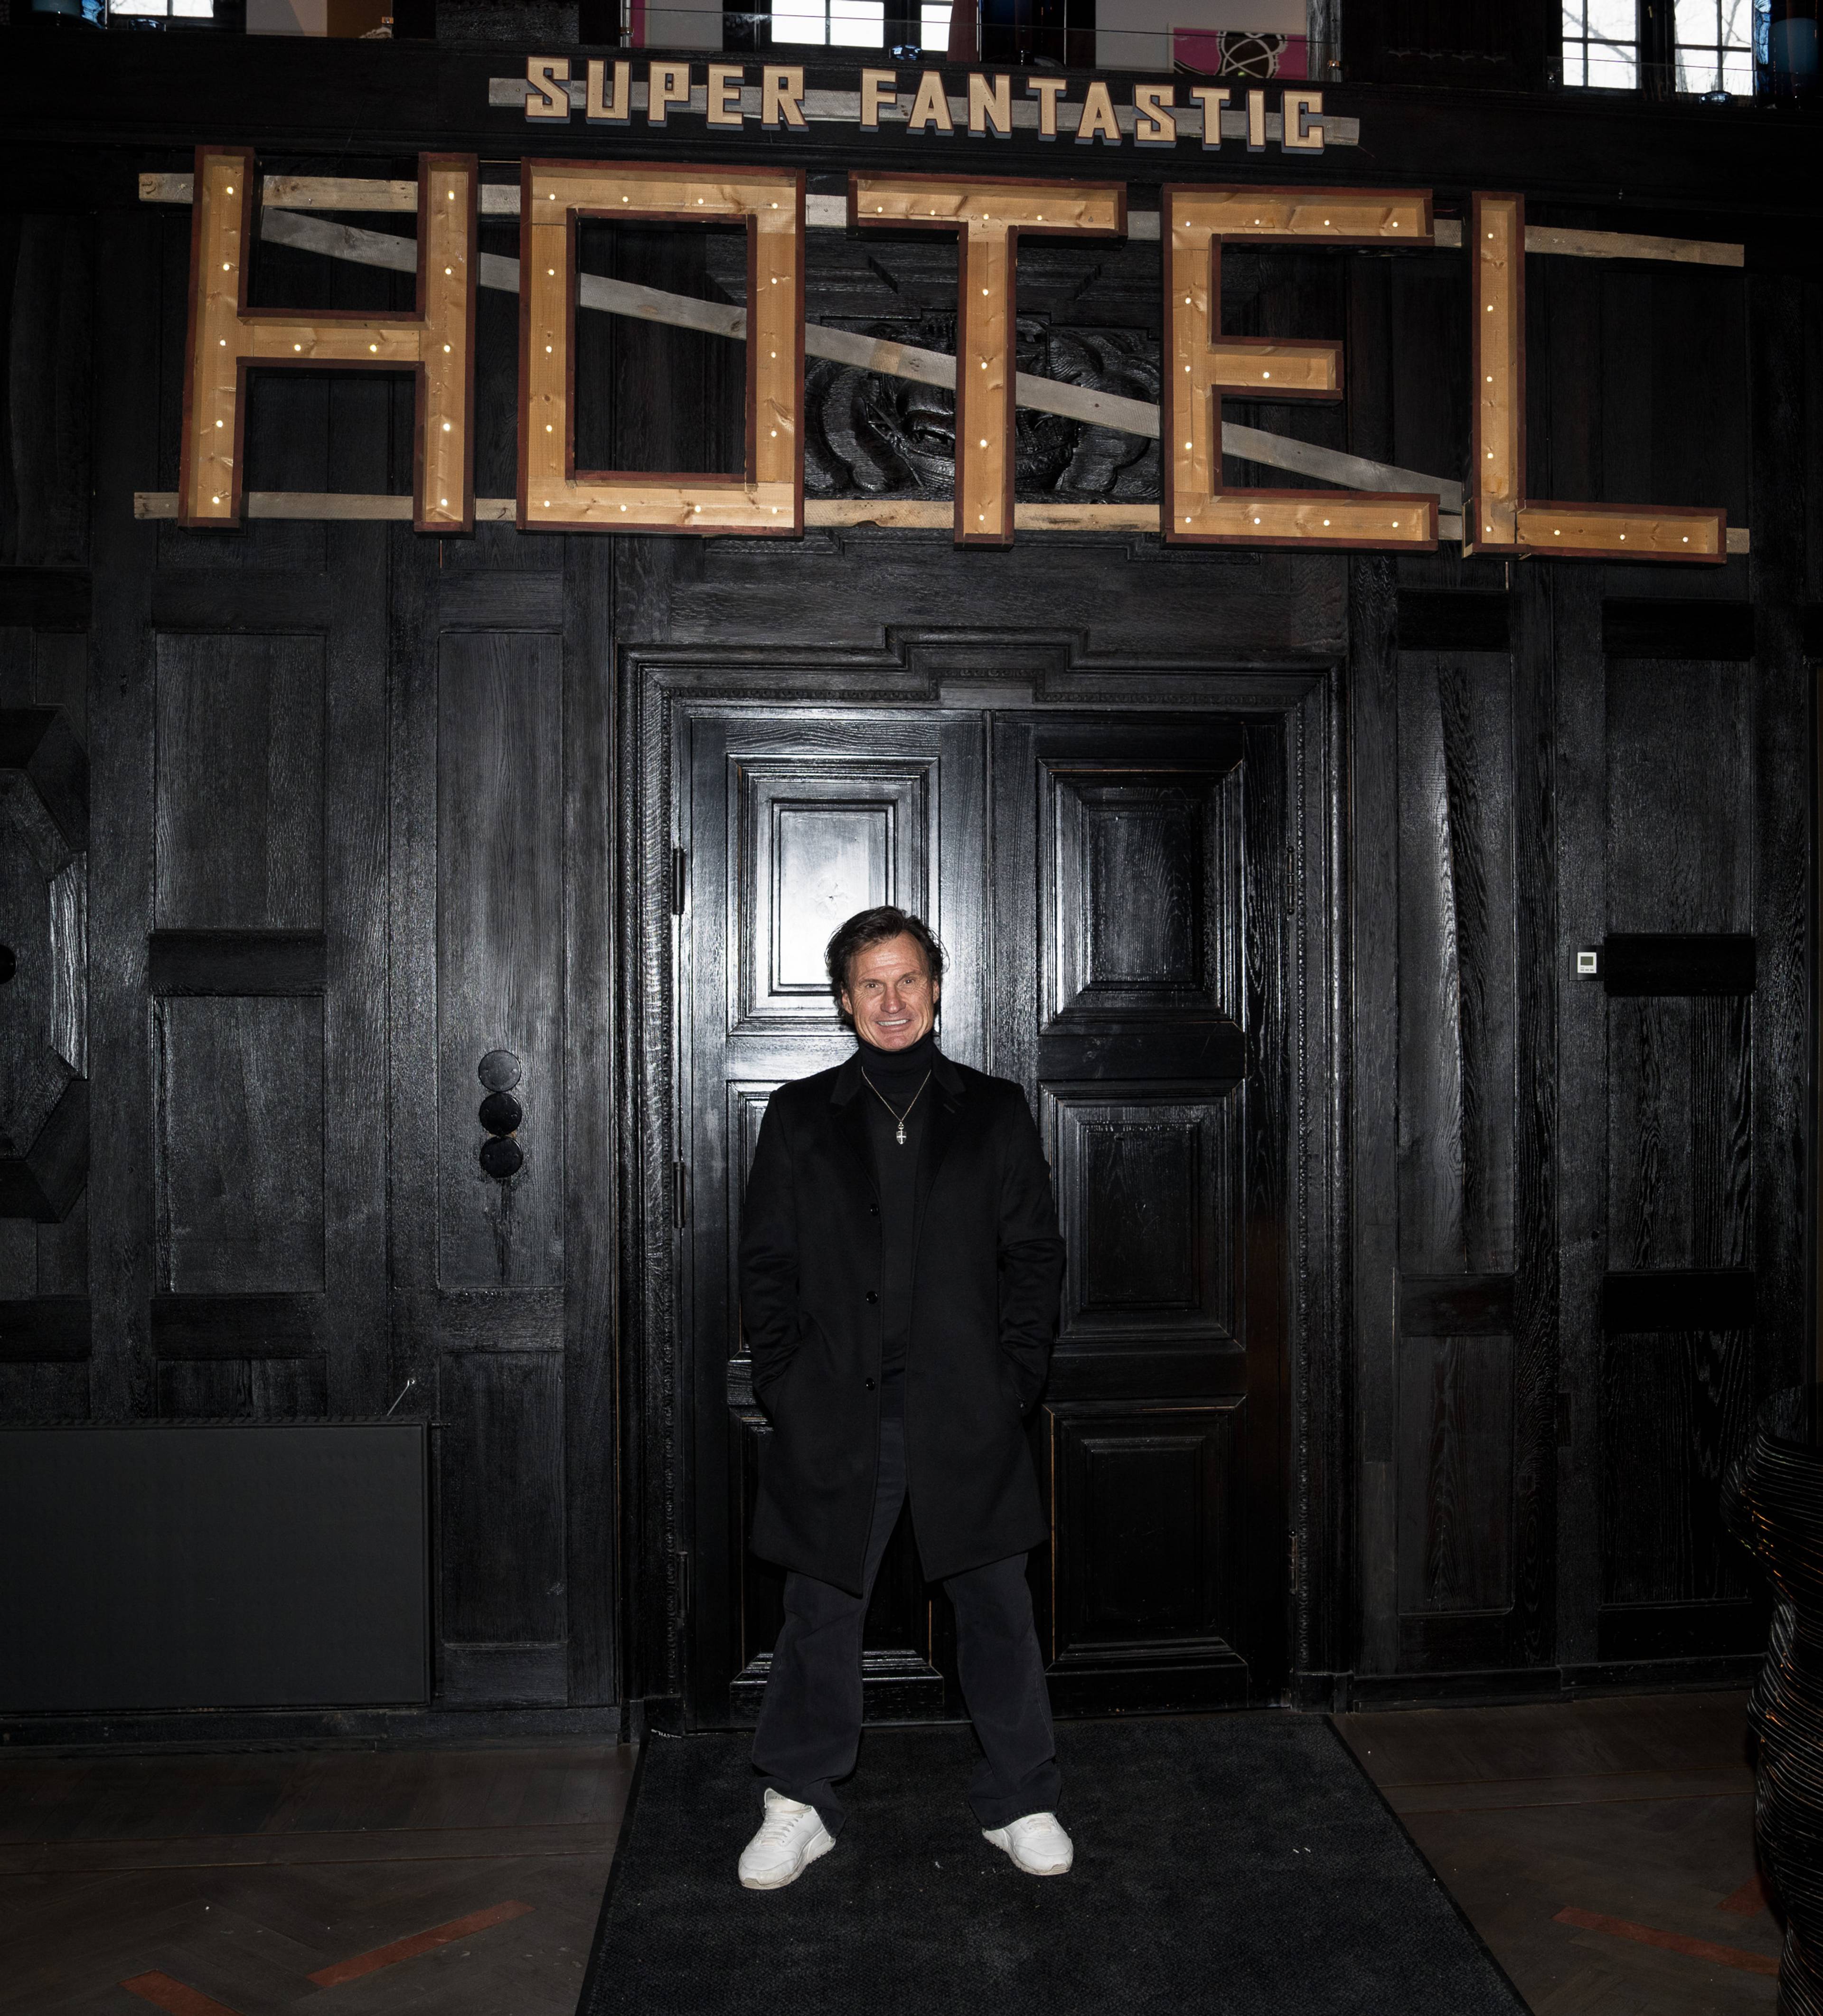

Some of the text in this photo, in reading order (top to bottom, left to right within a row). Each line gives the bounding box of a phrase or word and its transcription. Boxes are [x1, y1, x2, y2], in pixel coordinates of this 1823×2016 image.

[525, 56, 1324, 154] SUPER FANTASTIC
[179, 144, 1728, 564] HOTEL
